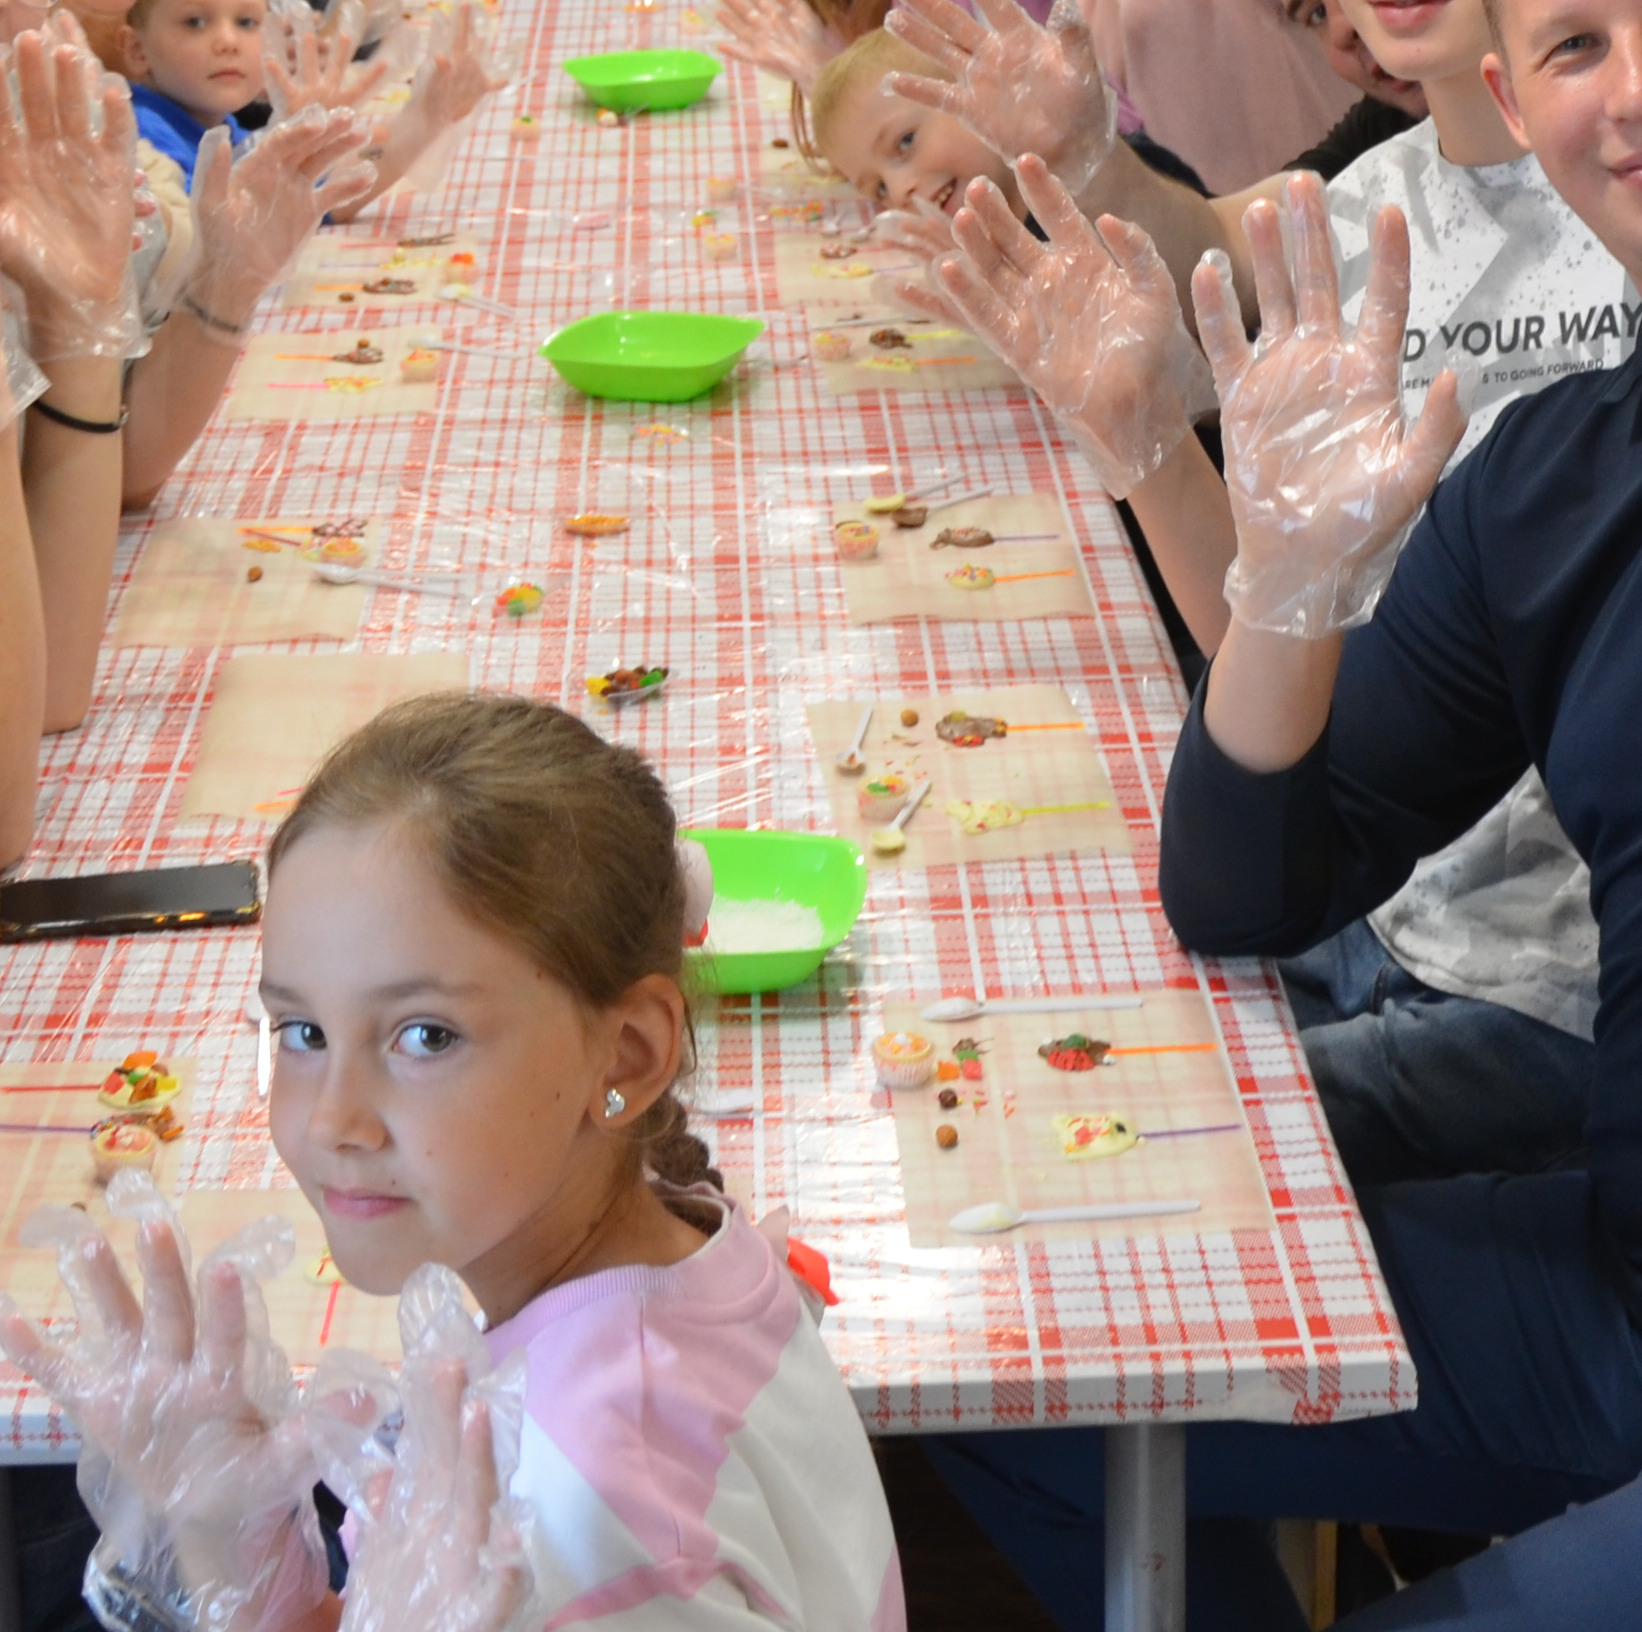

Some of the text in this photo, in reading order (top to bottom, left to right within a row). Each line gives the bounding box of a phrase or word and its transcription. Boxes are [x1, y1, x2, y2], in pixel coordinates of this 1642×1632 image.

[1403, 328, 1427, 362] D
[1440, 315, 1545, 356] YOUR
[1494, 371, 1508, 383] TO
[1510, 367, 1544, 381] GOING
[1547, 359, 1604, 374] FORWARD
